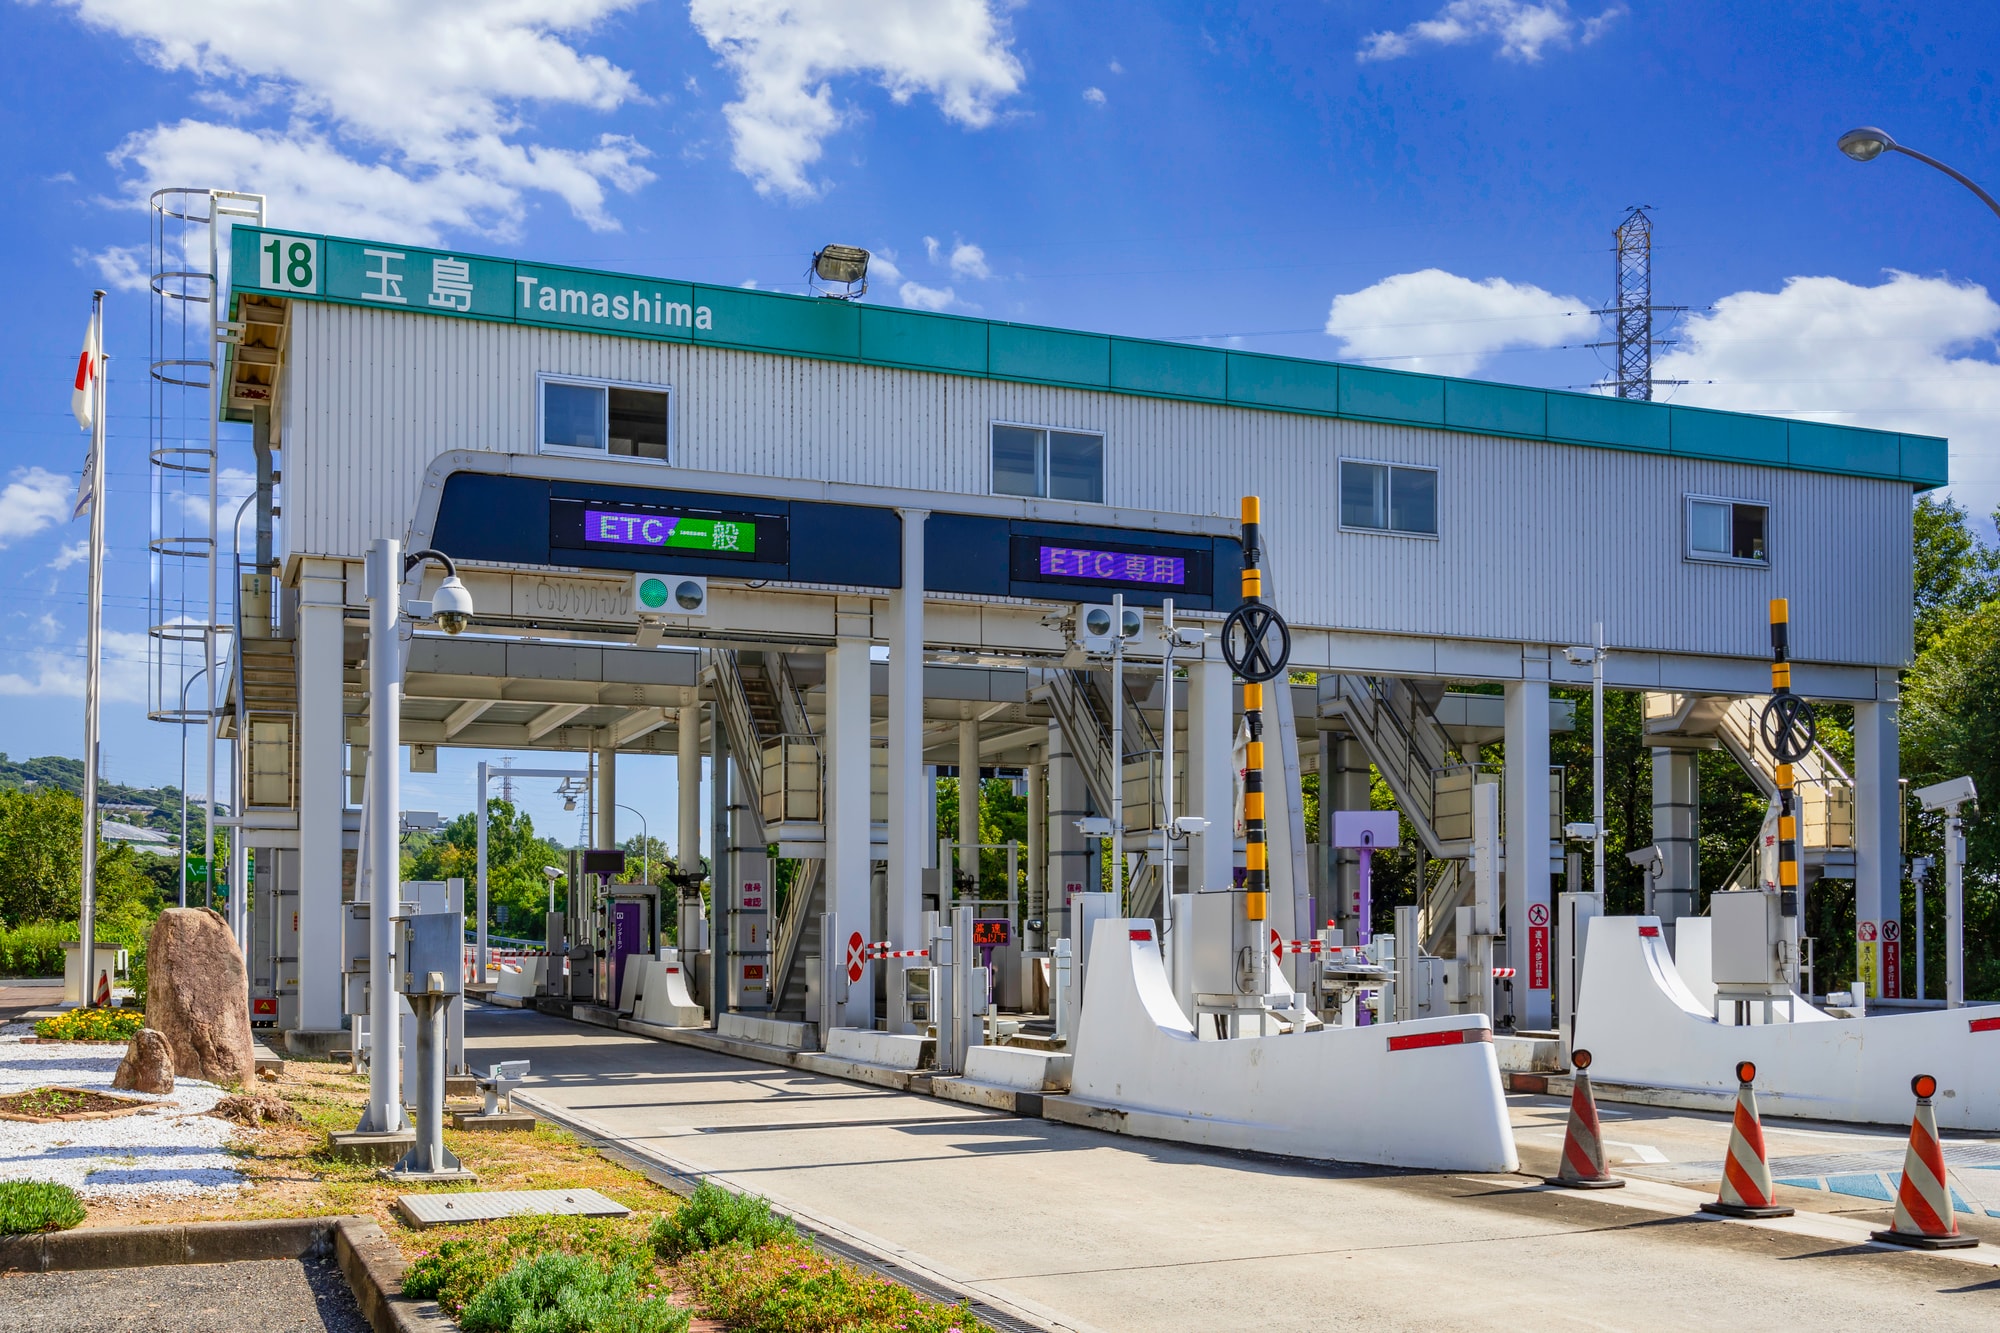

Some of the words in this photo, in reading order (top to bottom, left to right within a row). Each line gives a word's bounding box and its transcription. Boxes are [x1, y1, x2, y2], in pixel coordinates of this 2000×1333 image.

[263, 239, 313, 288] 18
[361, 248, 474, 312] 玉島
[517, 276, 712, 331] Tamashima
